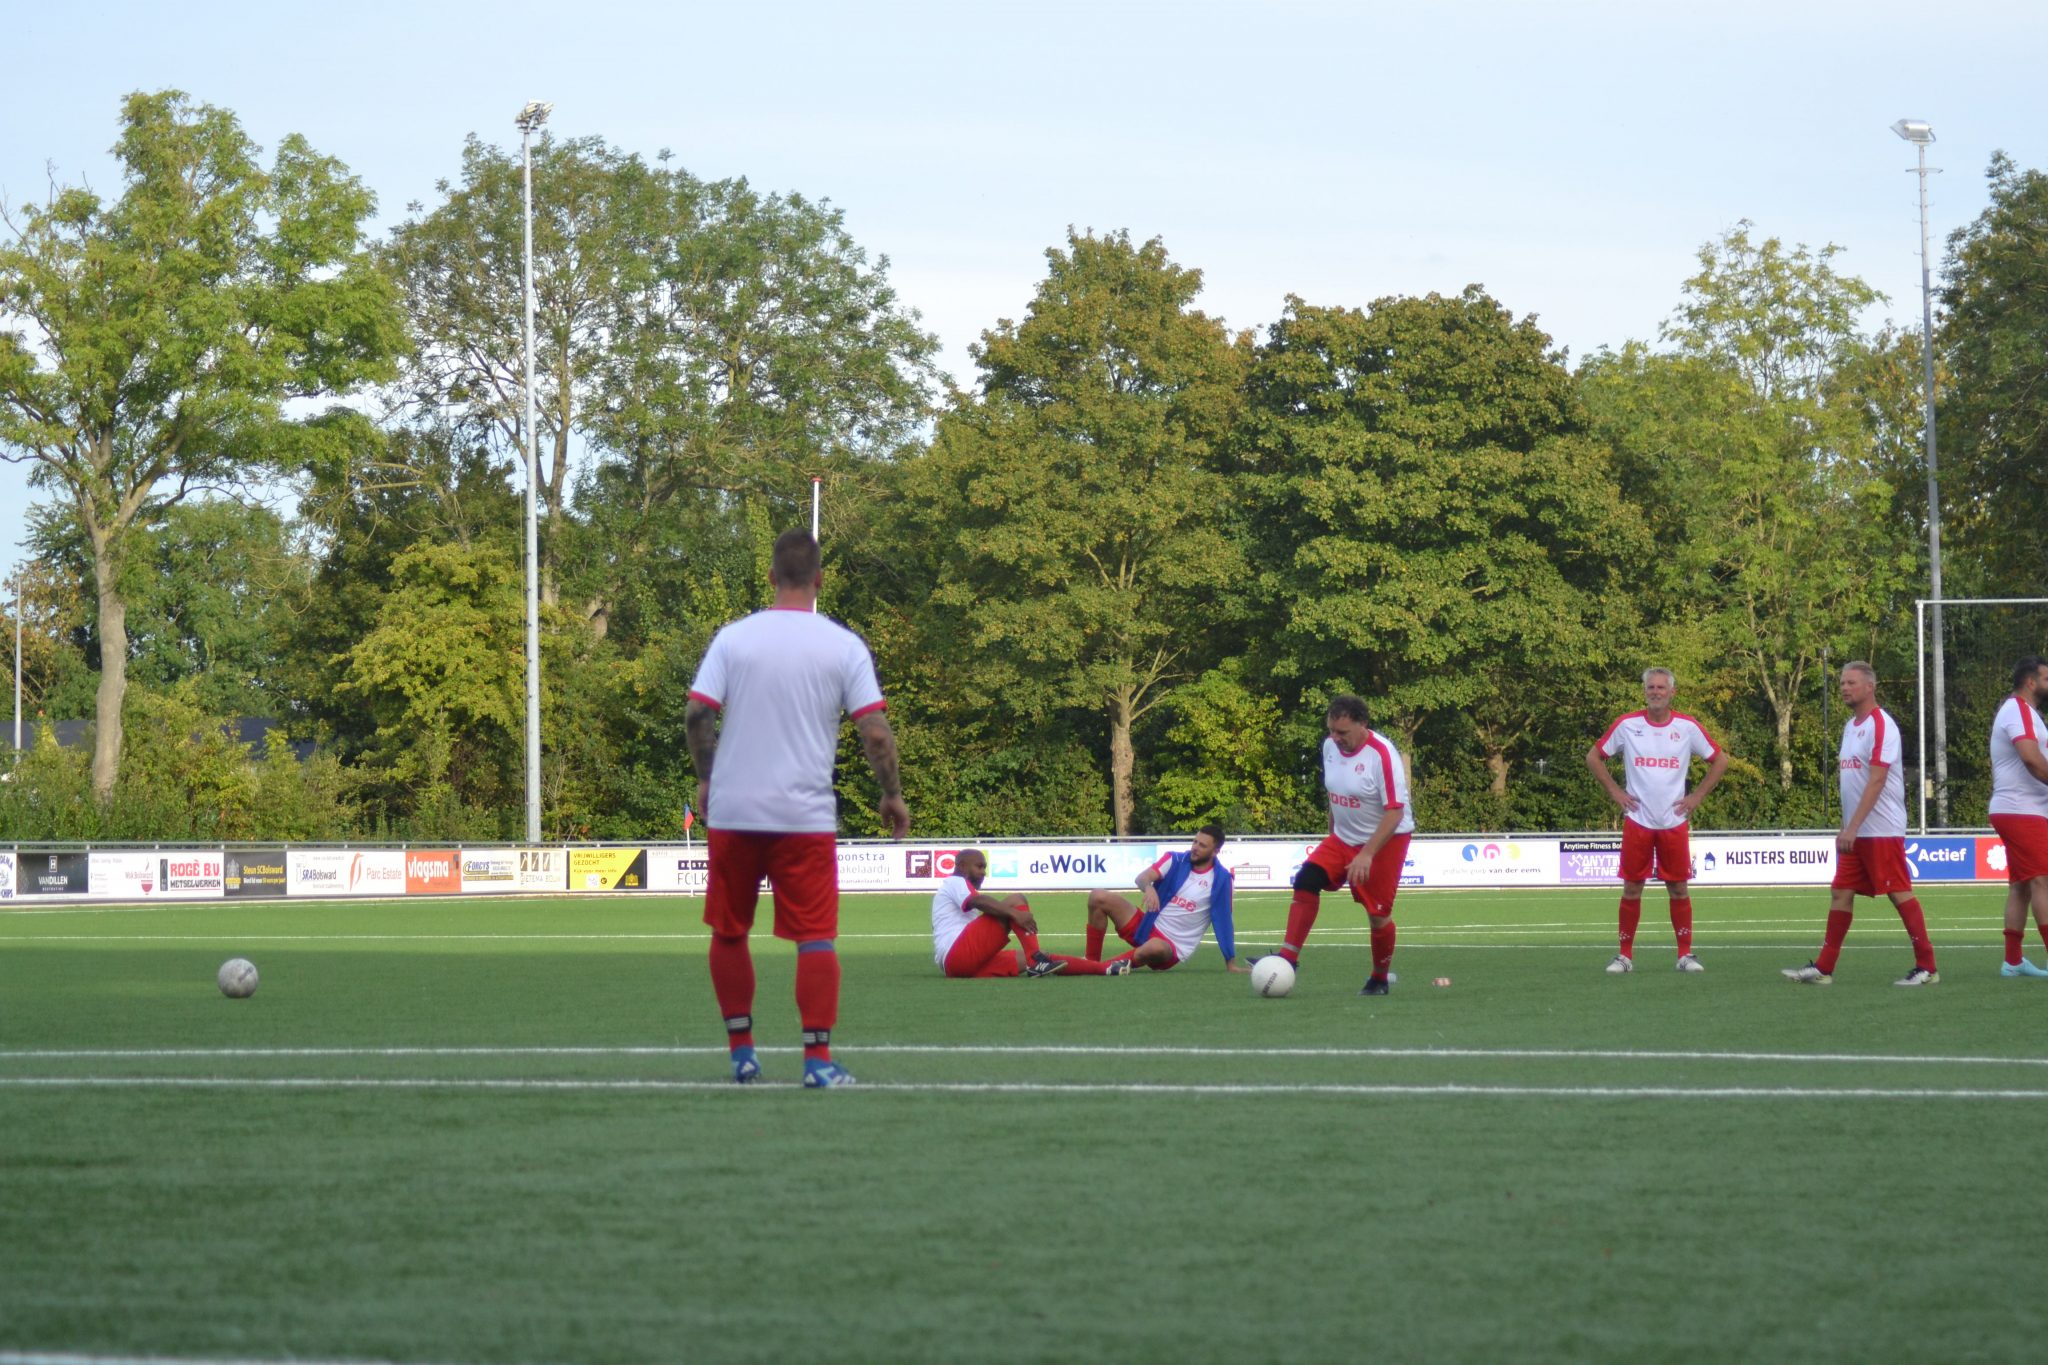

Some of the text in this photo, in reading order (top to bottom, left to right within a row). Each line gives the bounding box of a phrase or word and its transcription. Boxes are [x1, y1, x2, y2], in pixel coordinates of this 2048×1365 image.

[1563, 842, 1589, 851] Anytime
[1590, 842, 1611, 850] Fitness
[838, 852, 885, 861] oonstra
[1726, 850, 1829, 864] KUSTERS BOUW
[1918, 848, 1967, 862] Actief
[366, 868, 402, 879] Parc Estate
[408, 856, 448, 883] vlagsma
[840, 864, 890, 876] akelaardij
[1582, 866, 1620, 877] FITNE
